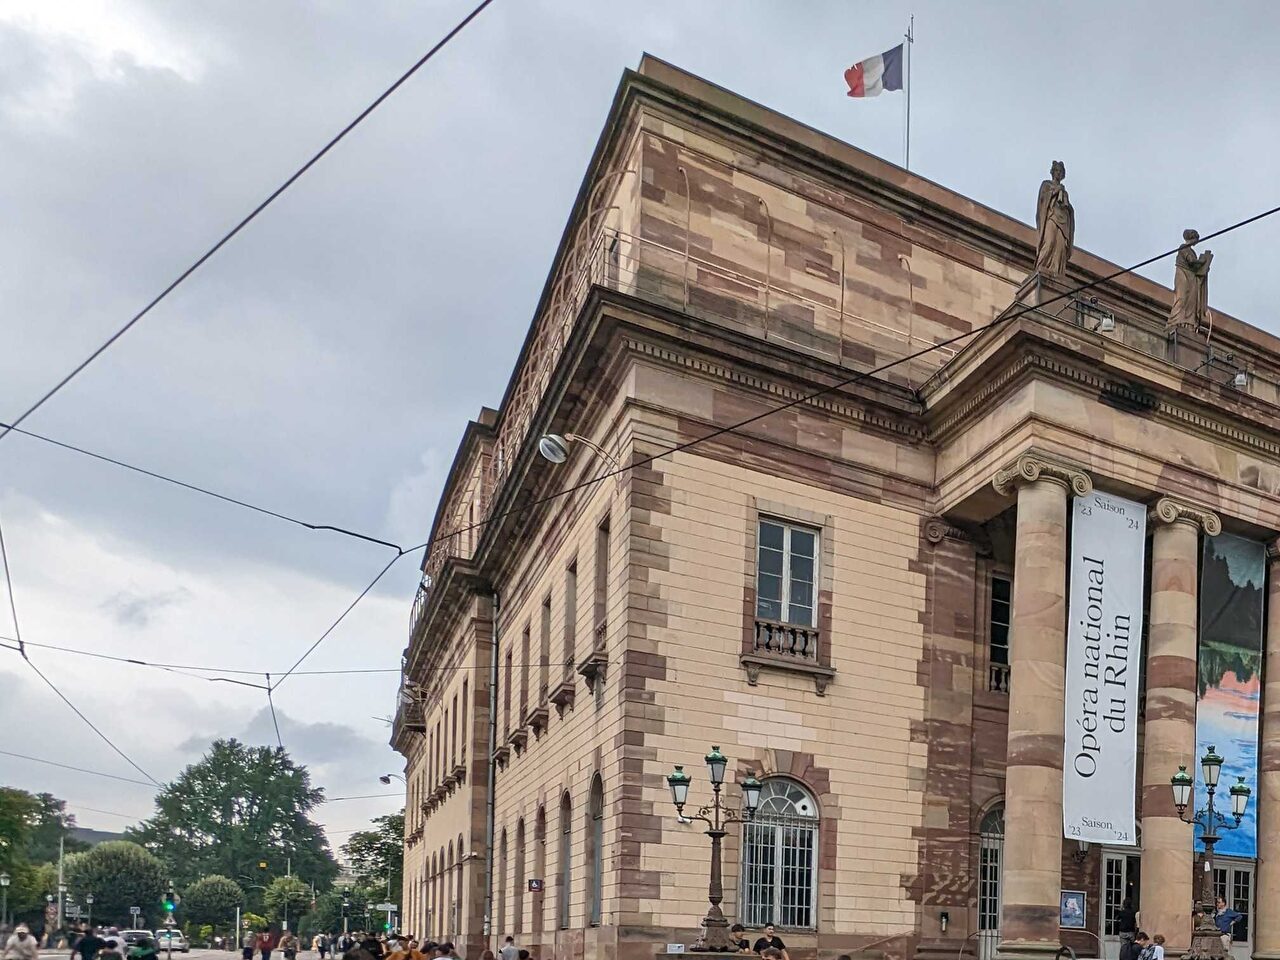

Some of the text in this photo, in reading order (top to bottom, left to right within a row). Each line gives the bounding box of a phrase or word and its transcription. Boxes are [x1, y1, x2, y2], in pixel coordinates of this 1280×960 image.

[1094, 497, 1125, 515] Saison
[1126, 517, 1139, 530] '24
[1074, 556, 1105, 778] Opéra national
[1103, 614, 1131, 733] du Rhin
[1081, 816, 1113, 830] Saison
[1114, 831, 1128, 841] '24
